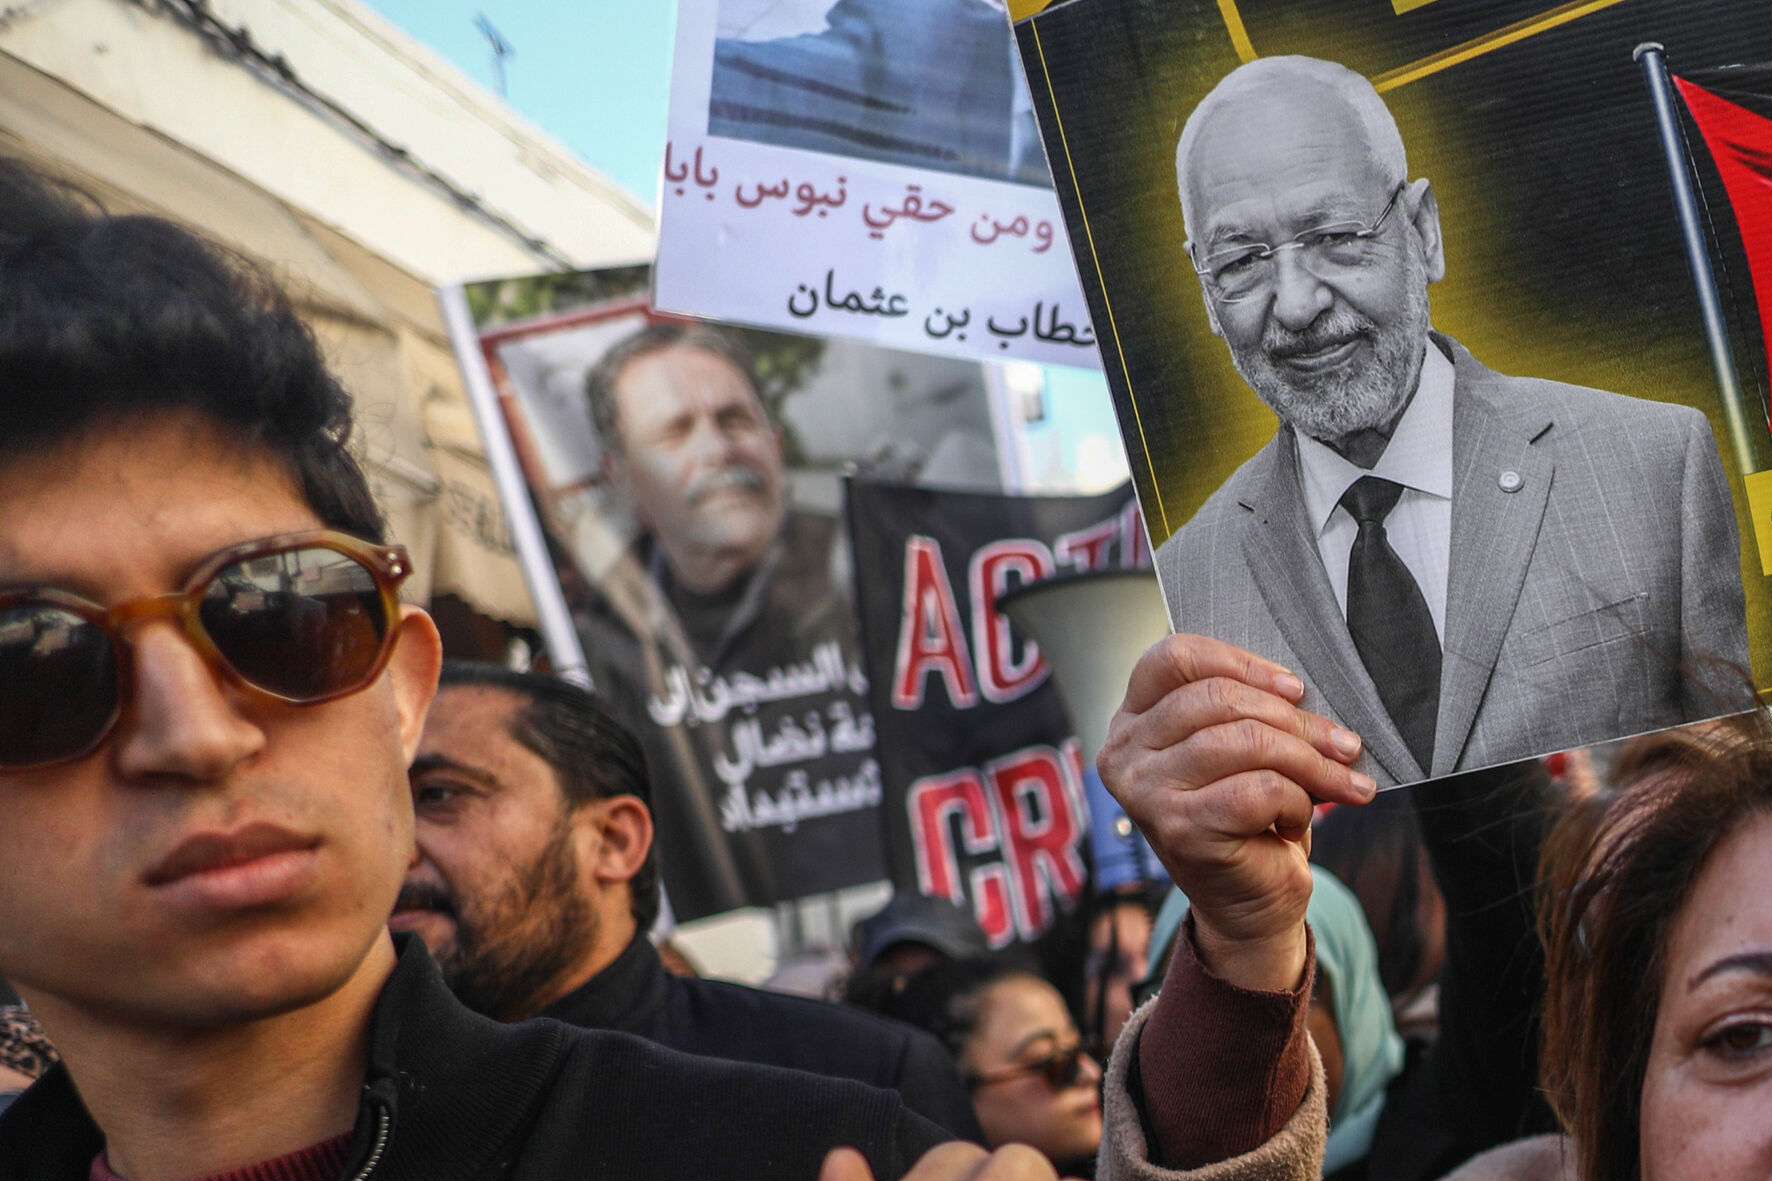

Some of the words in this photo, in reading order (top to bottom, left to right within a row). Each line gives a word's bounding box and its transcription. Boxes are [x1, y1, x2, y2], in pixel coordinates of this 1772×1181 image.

[663, 141, 719, 200] بابا
[735, 174, 848, 218] نبوس
[862, 184, 956, 240] حقي
[970, 212, 1054, 254] ومن
[787, 269, 910, 319] عثمان
[924, 304, 971, 341] بن
[697, 640, 848, 723] السجن
[713, 712, 828, 786] نضال
